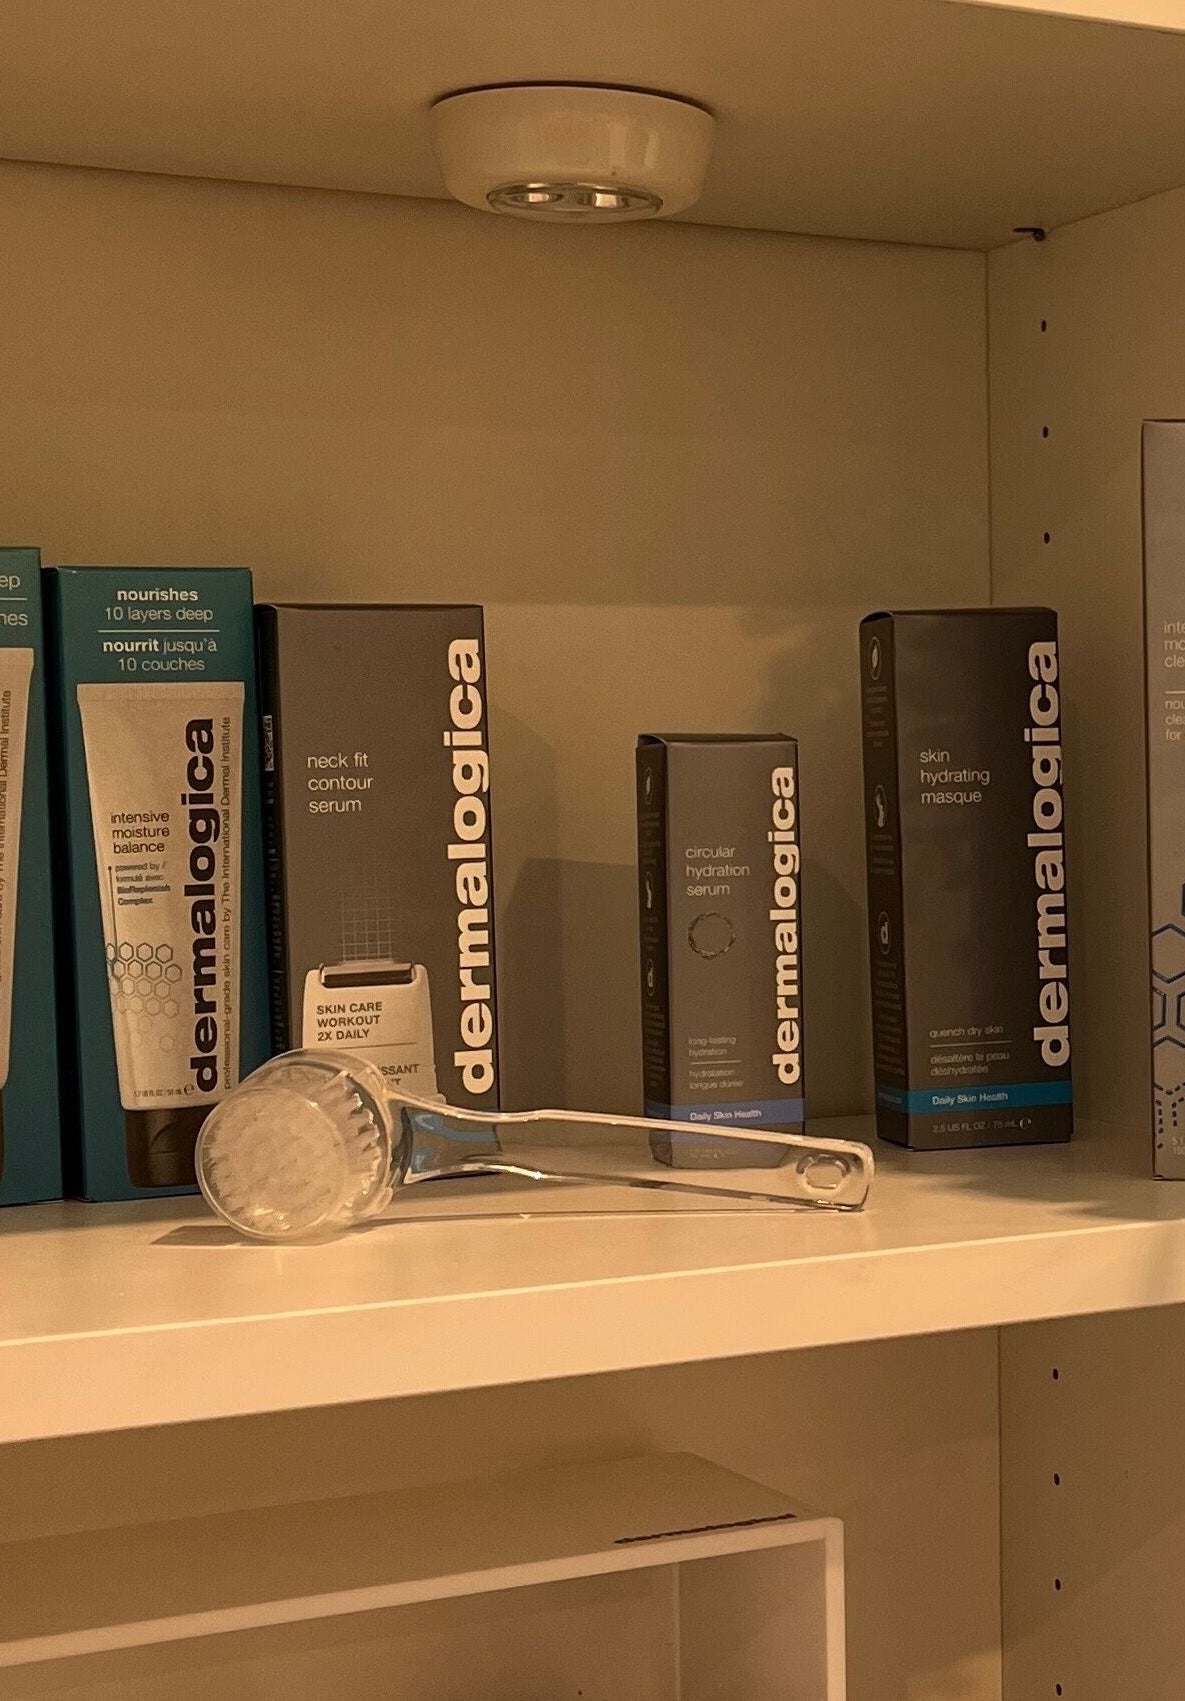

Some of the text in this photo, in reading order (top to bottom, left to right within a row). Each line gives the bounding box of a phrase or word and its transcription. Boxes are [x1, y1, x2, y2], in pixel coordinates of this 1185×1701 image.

[117, 588, 198, 601] nourishes
[105, 606, 213, 624] 10 layers deep
[103, 638, 217, 655] nourrit jusqu'à
[118, 657, 205, 671] 10 couches
[1, 690, 11, 734] Institute
[220, 717, 231, 762] Institute
[1166, 729, 1182, 740] for
[307, 752, 368, 769] neck fit
[920, 749, 950, 763] skin
[308, 776, 374, 791] contour
[920, 768, 990, 787] hydrating
[221, 766, 230, 806] Dermal
[921, 791, 982, 806] masque
[309, 800, 362, 813] serum
[111, 811, 170, 824] intensive
[112, 826, 170, 839] moisture
[113, 842, 165, 854] balance
[221, 808, 231, 879] International
[685, 845, 736, 859] circular
[1025, 641, 1071, 1067] dermalogica
[444, 638, 495, 1095] dermalogica
[686, 864, 751, 880] hydration
[221, 883, 230, 905] The
[686, 885, 730, 896] serum
[181, 718, 220, 1093] dermalogica
[222, 908, 231, 922] by
[768, 766, 801, 1085] dermalogica
[222, 953, 231, 978] skin
[316, 1002, 382, 1015] SKIN CARE
[317, 1015, 380, 1028] WORKOUT
[318, 1029, 370, 1042] 2X DAILY
[929, 1025, 1003, 1039] quench dry skin
[986, 1052, 1010, 1064] peau
[932, 1092, 1008, 1106] Daily Skin Health
[690, 1109, 762, 1122] Daily Skin Health
